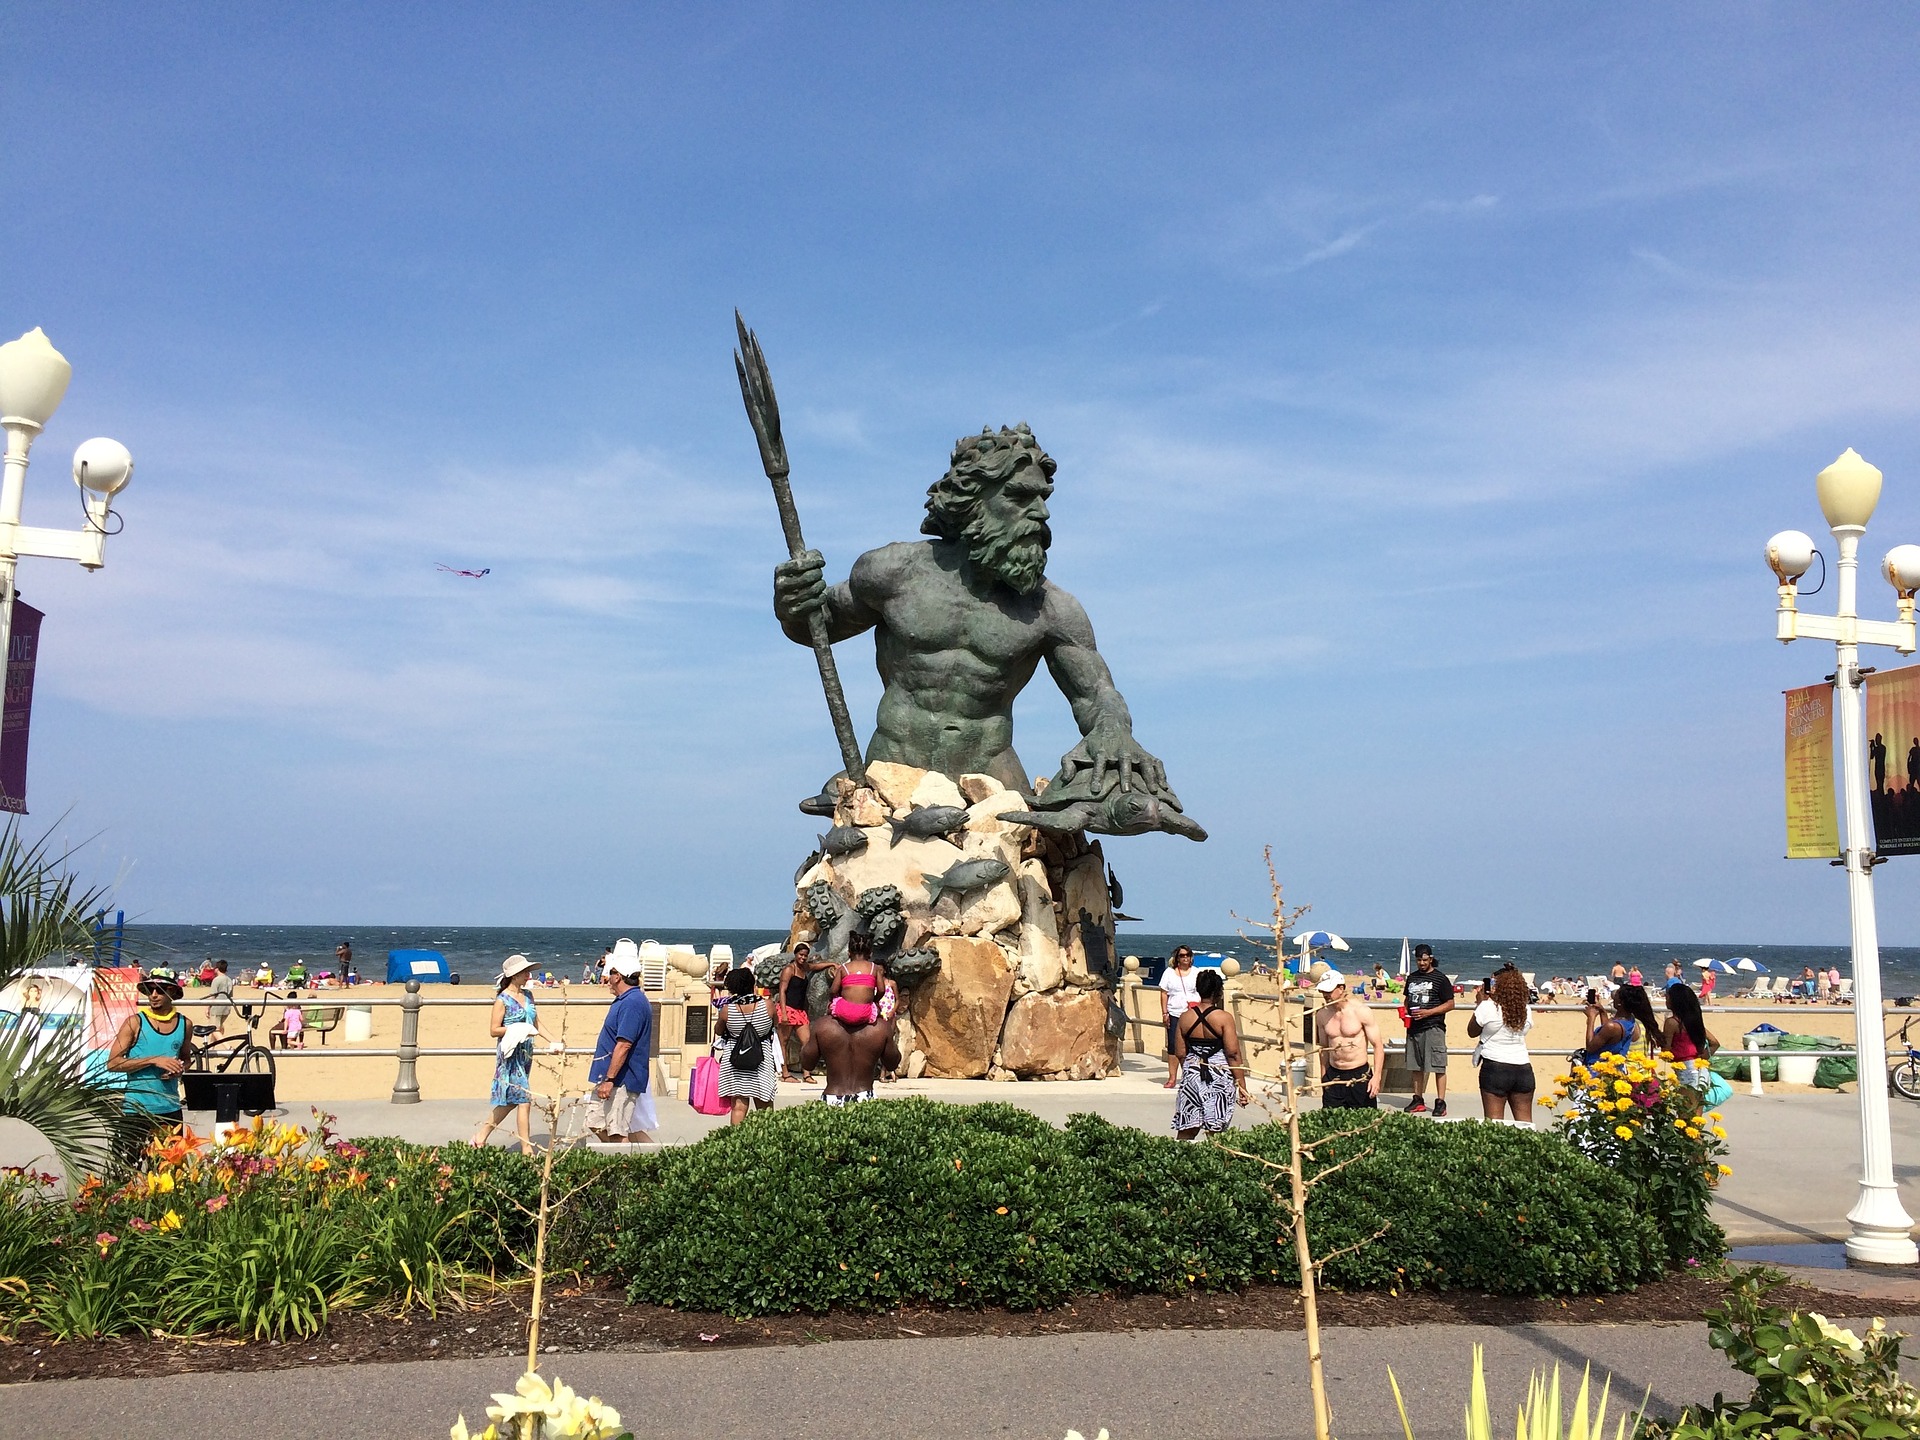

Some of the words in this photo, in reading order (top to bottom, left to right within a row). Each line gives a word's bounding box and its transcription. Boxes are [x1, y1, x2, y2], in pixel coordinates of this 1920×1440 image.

[7, 669, 26, 687] VERY
[1788, 689, 1810, 709] 2014
[1789, 698, 1822, 719] SUMMER
[1790, 706, 1825, 728] CONCERT
[1791, 722, 1813, 737] SERIES
[110, 992, 136, 1001] HUT
